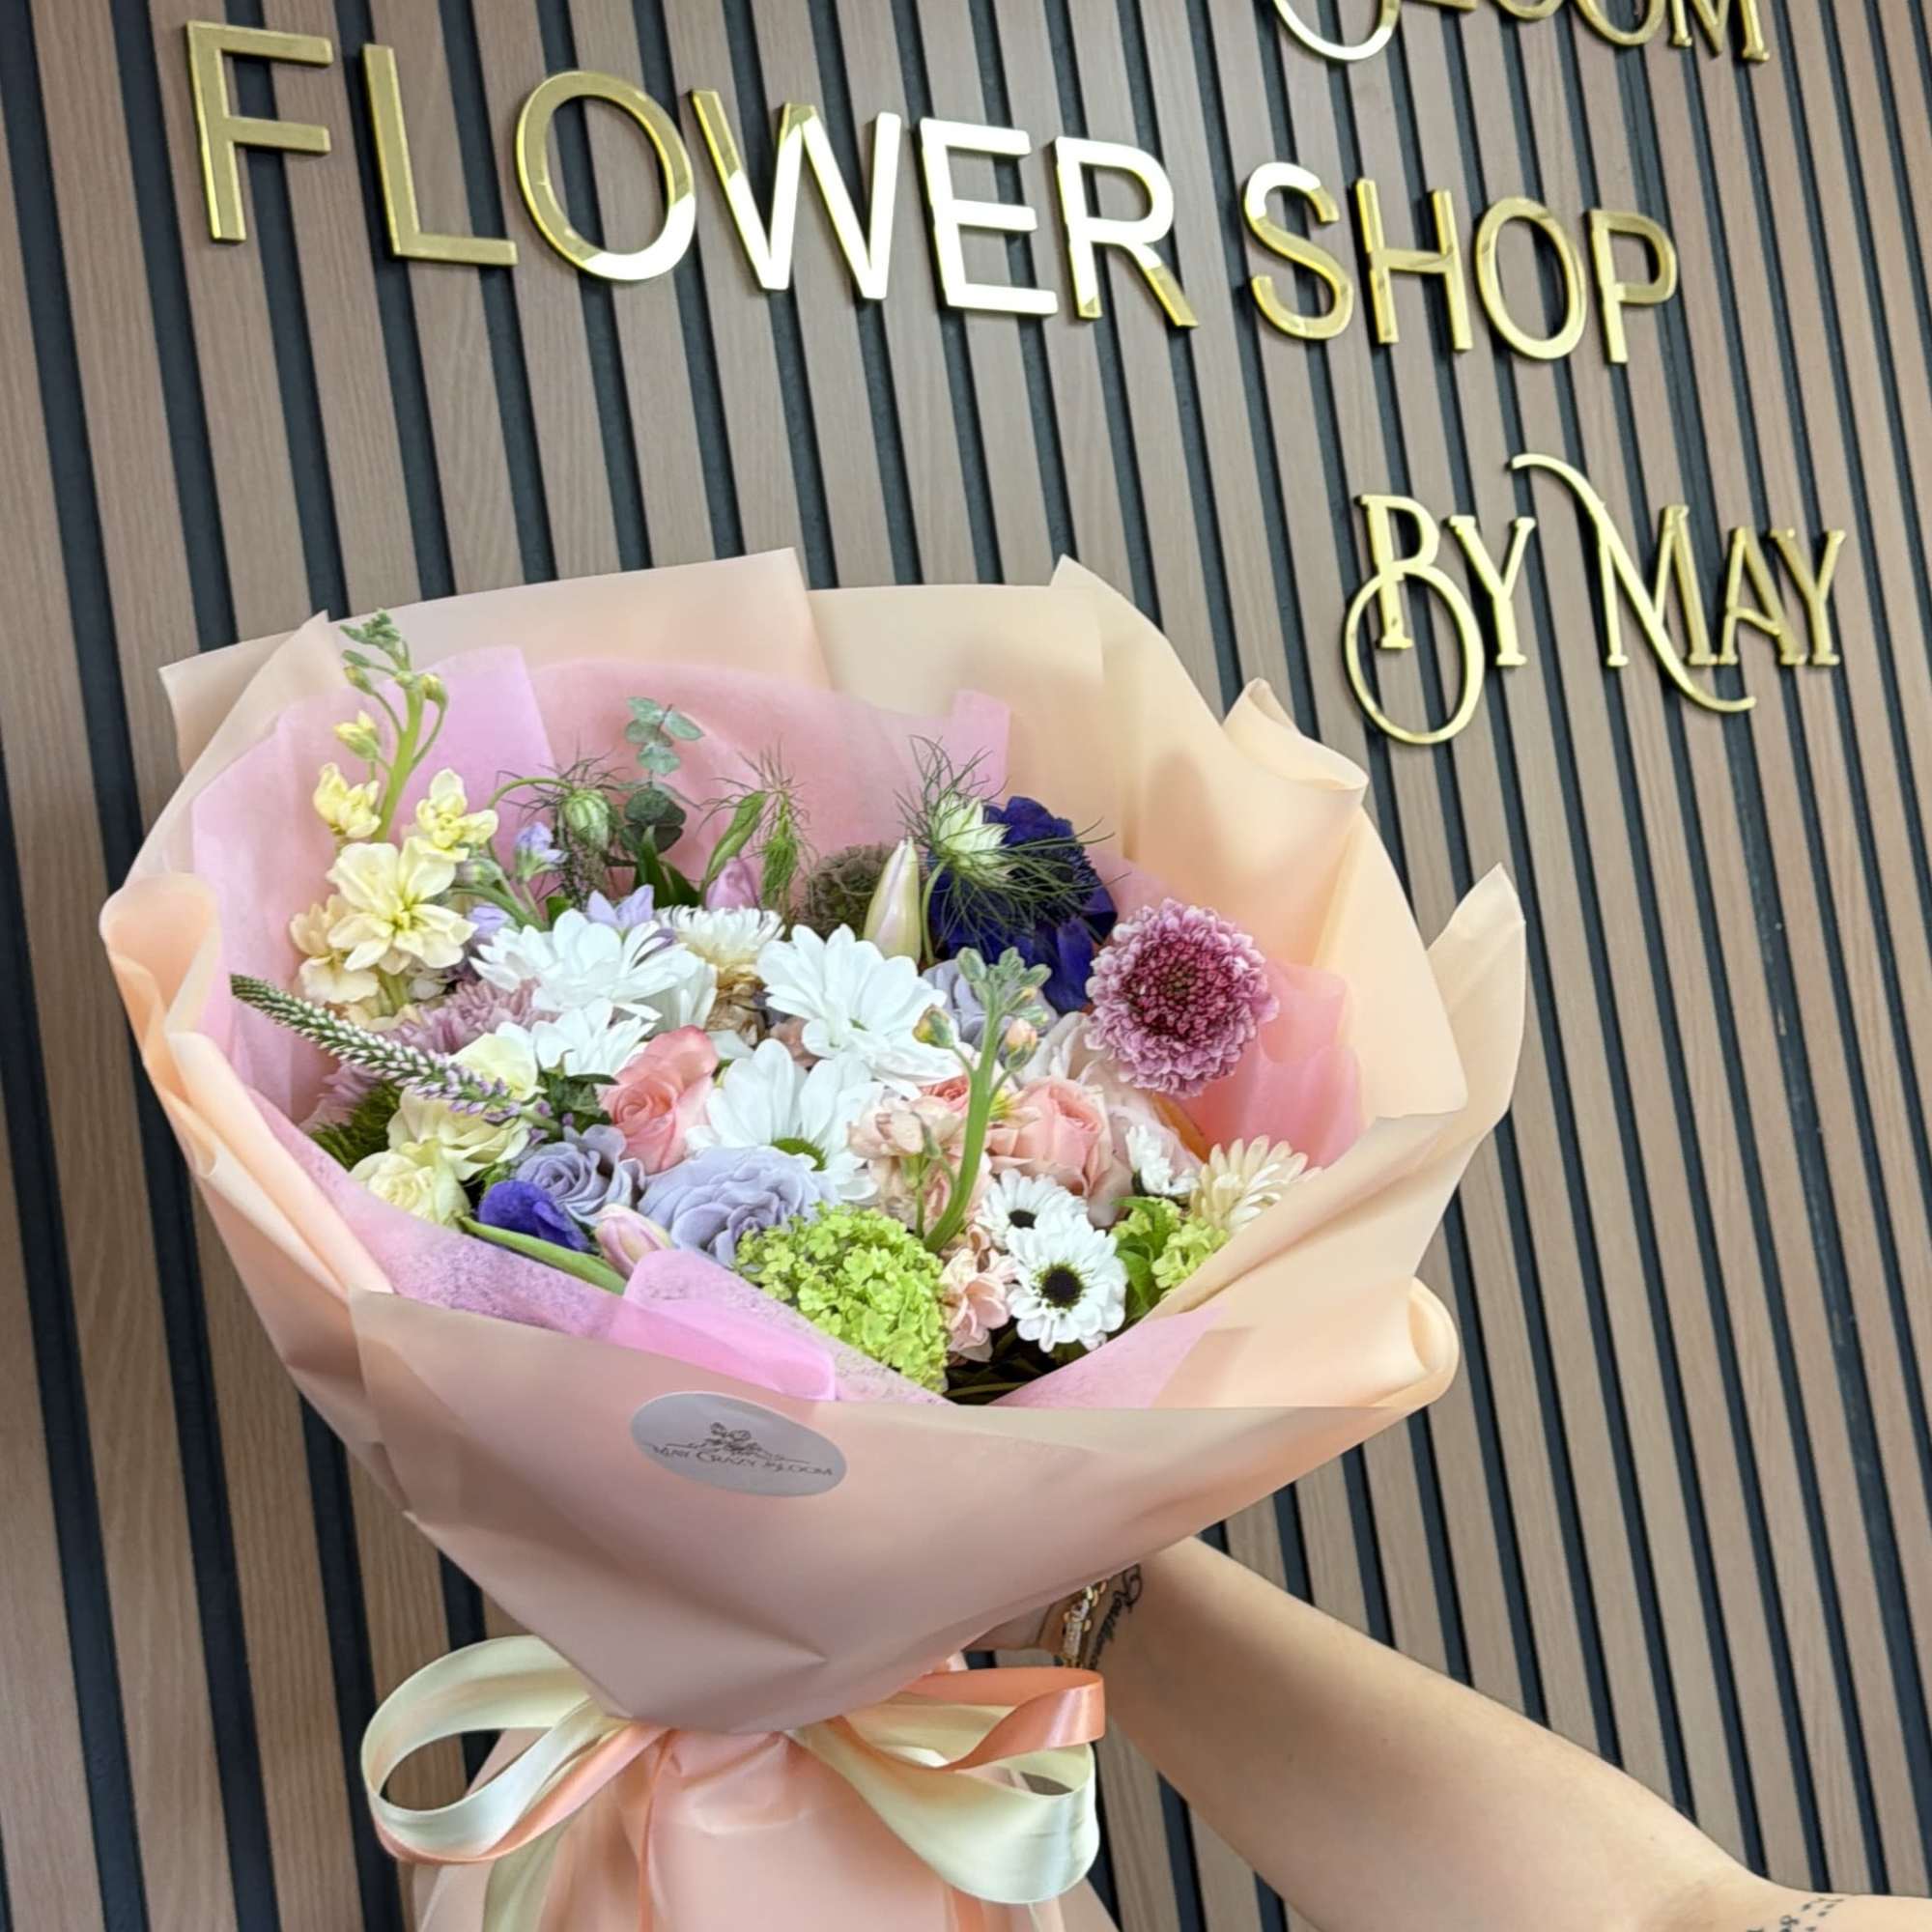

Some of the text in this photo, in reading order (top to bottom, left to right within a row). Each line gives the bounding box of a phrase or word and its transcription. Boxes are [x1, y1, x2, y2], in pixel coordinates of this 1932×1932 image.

[186, 21, 1678, 364] FLOWER SHOP
[1345, 452, 1847, 746] BY MAY
